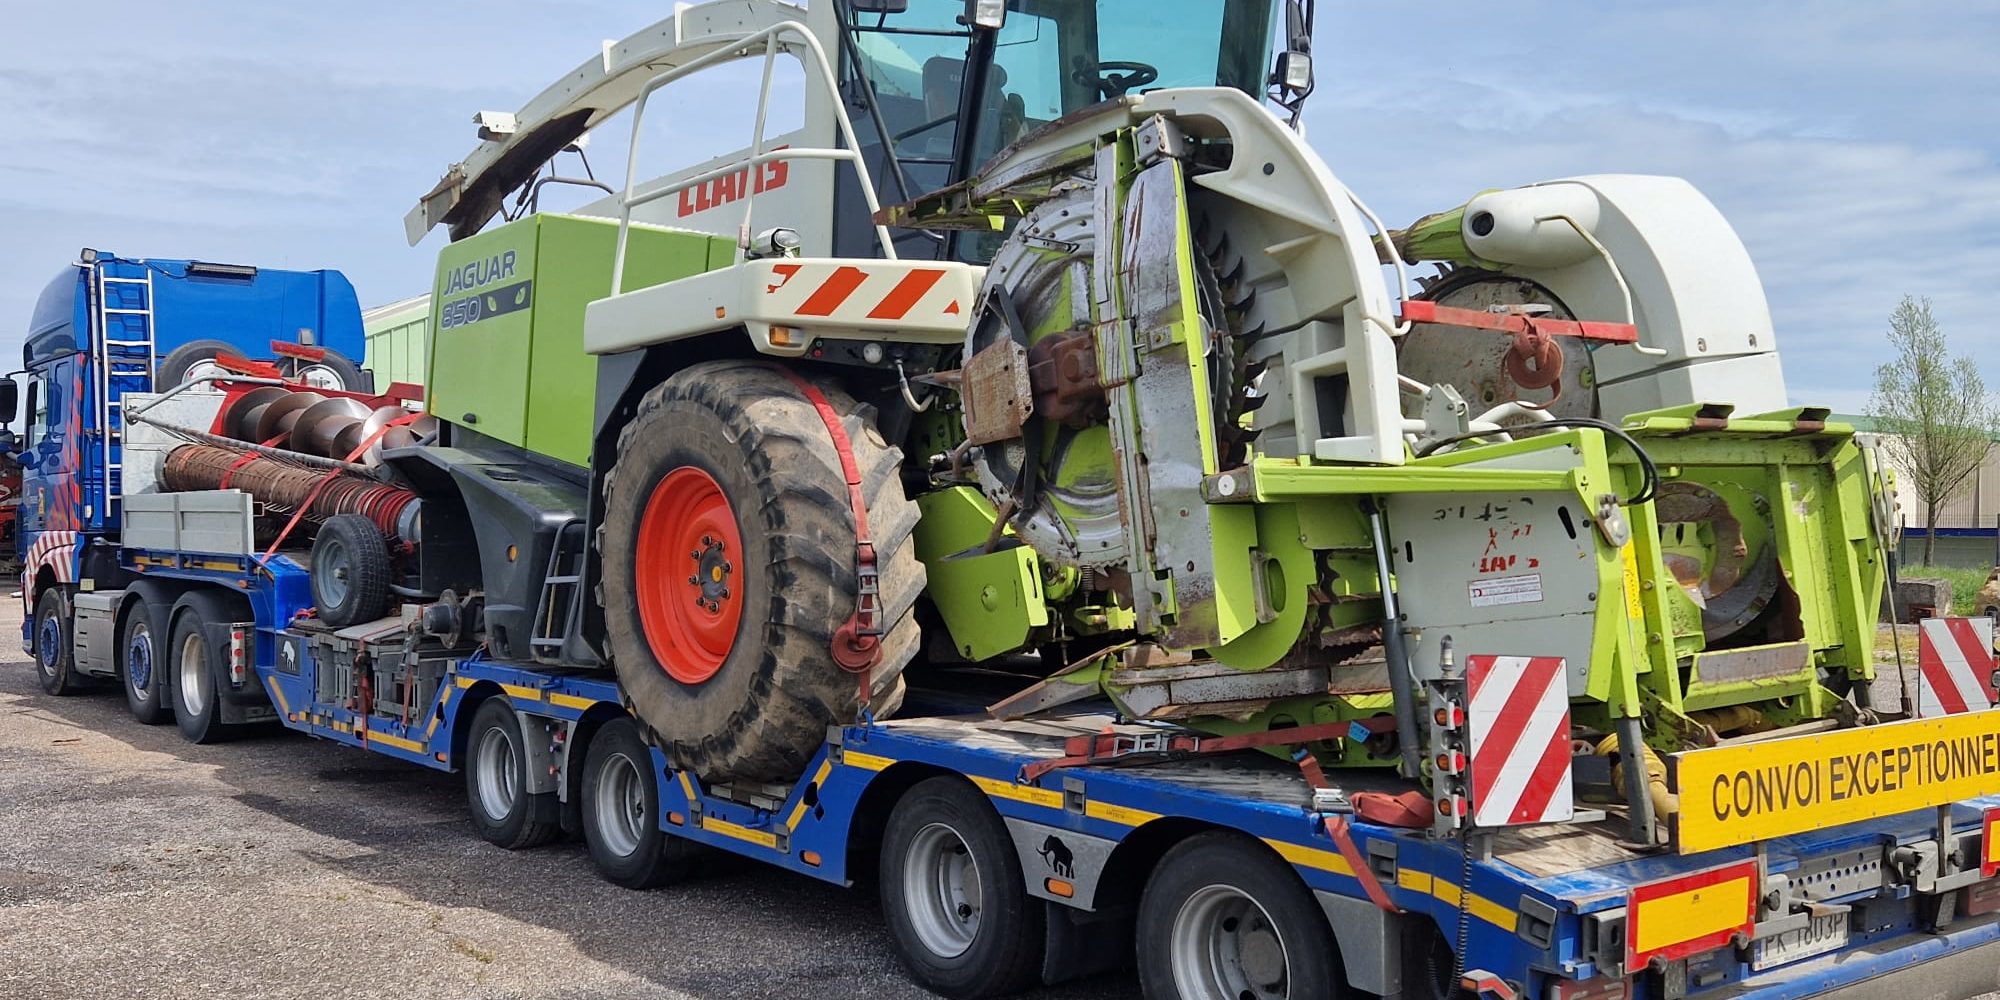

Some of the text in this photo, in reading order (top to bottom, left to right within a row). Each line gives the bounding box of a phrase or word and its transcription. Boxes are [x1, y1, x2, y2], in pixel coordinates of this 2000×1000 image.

[443, 249, 516, 297] JAGUAR
[441, 296, 481, 330] 850
[1712, 760, 1821, 822] CONVOI
